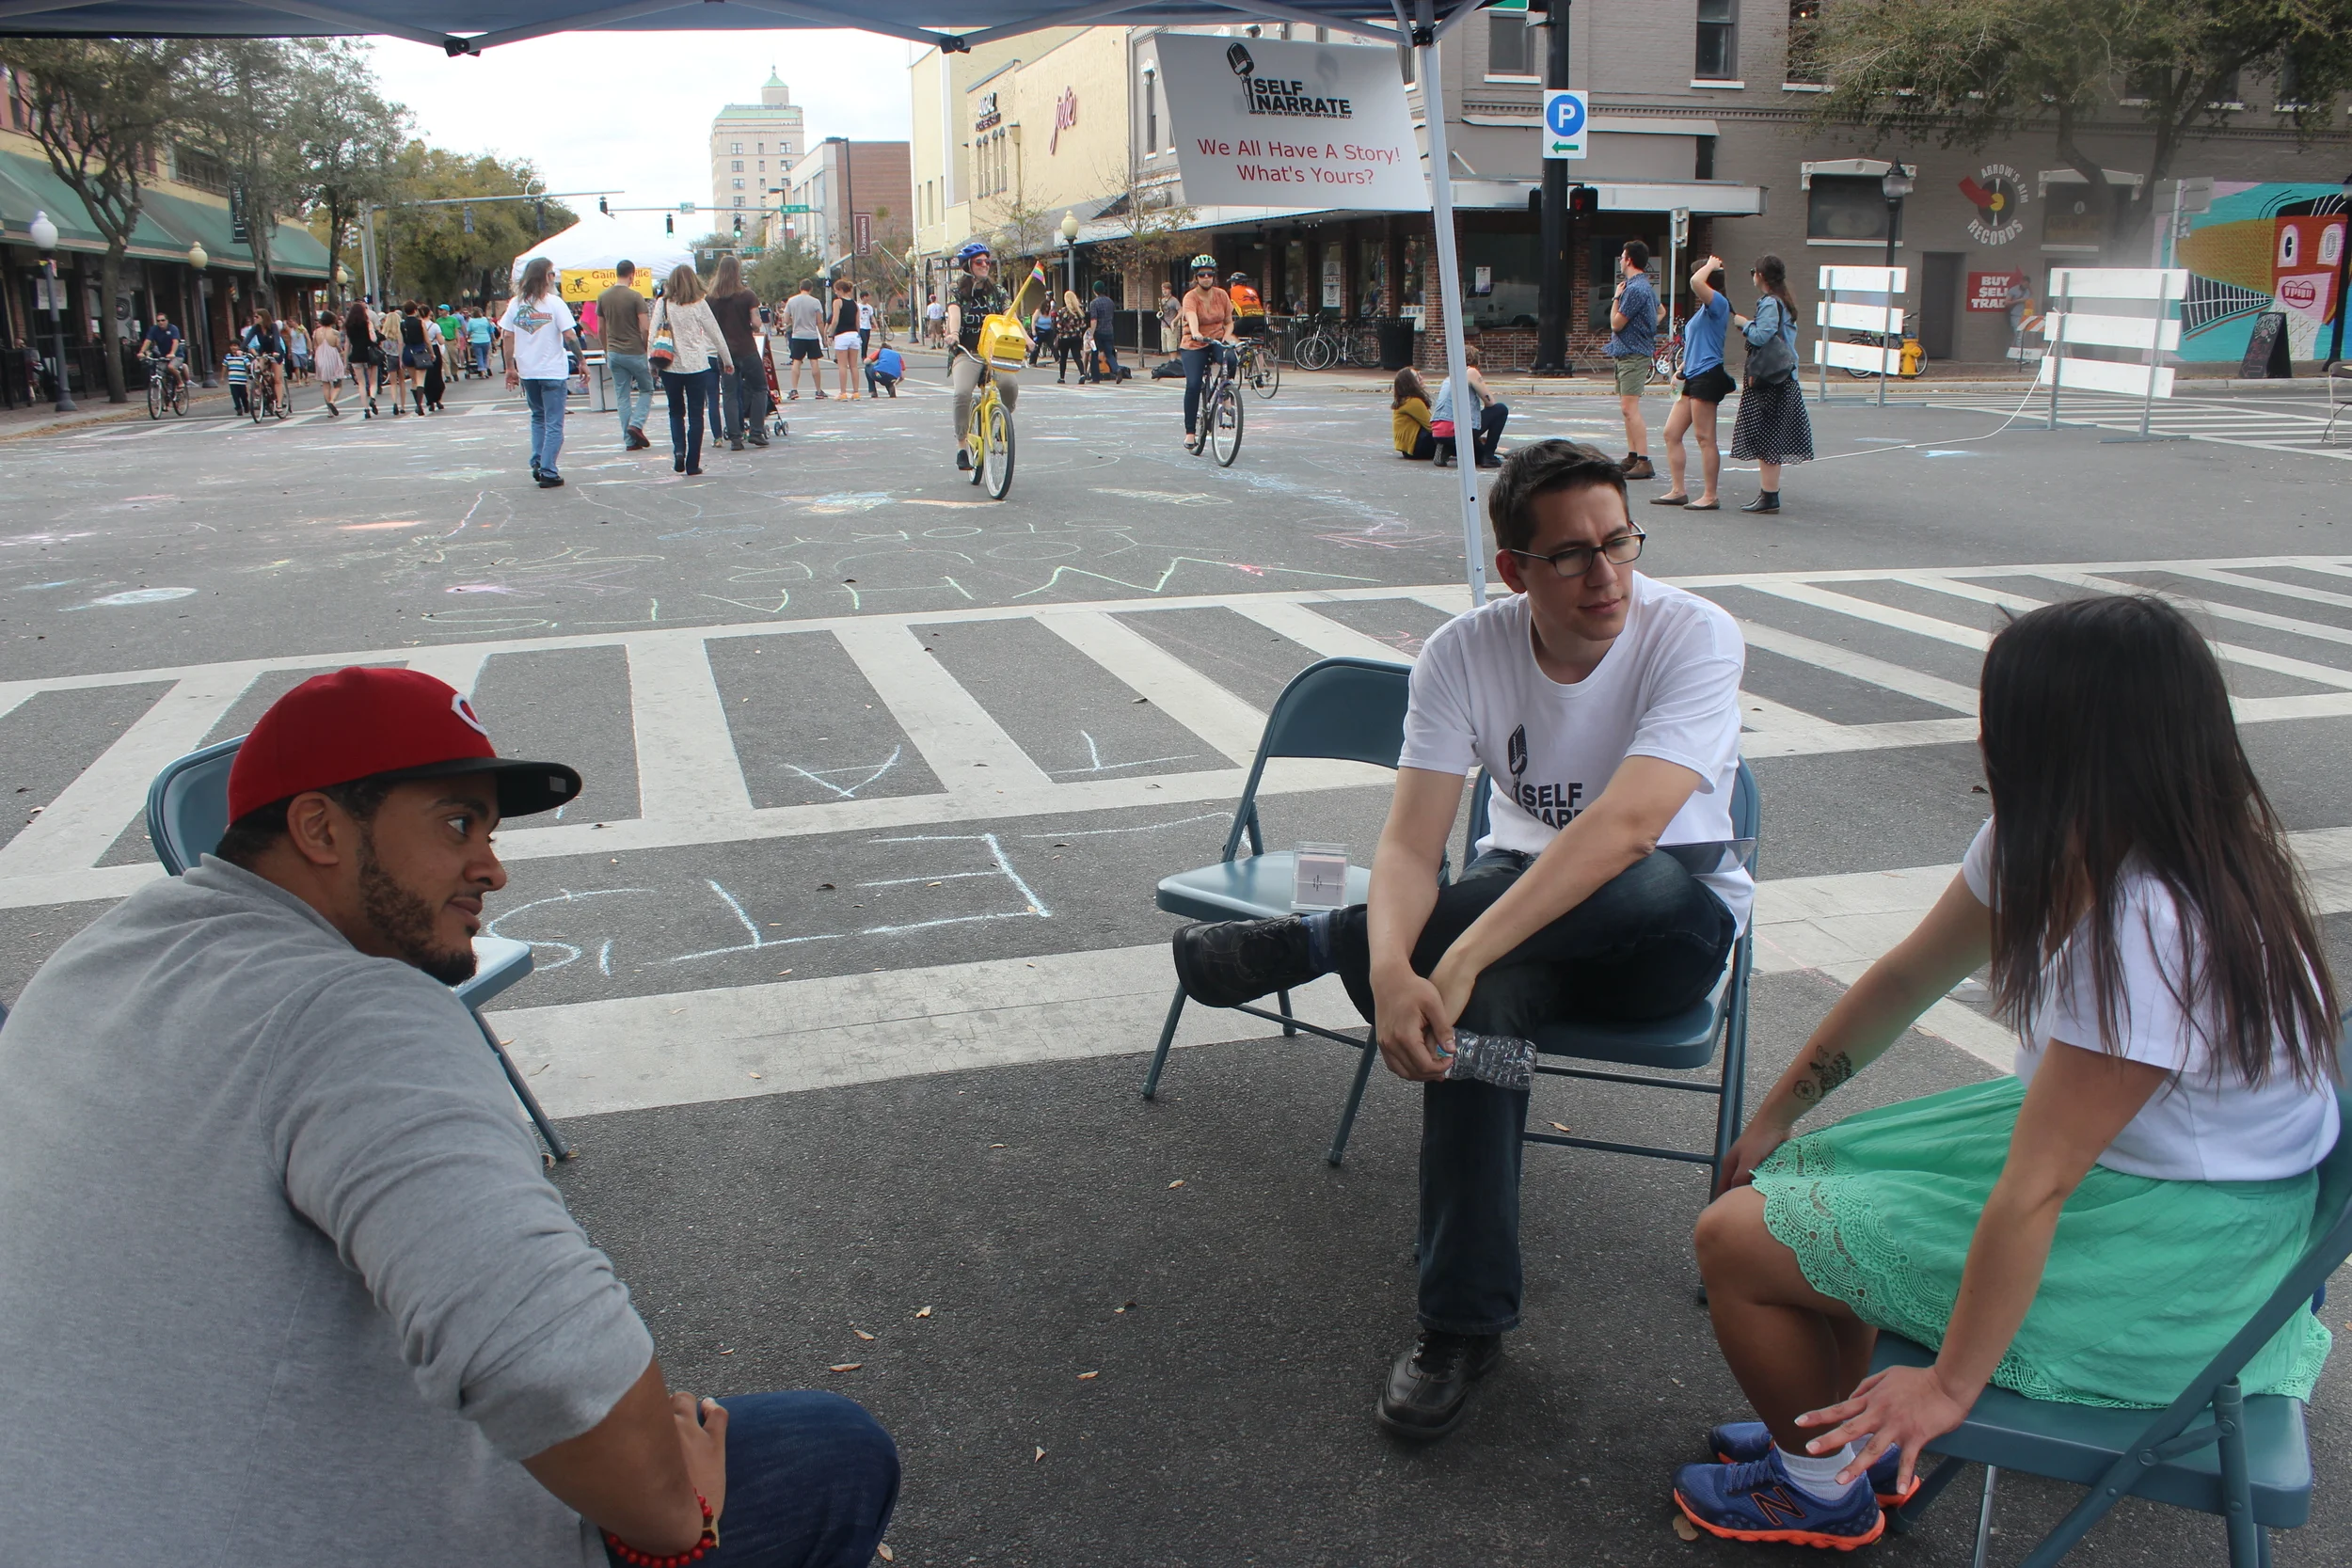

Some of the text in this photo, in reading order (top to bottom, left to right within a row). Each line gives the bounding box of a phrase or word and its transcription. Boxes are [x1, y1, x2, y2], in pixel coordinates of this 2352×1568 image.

[1253, 78, 1303, 96] SELF
[1256, 95, 1353, 115] NARRATE
[1558, 103, 1576, 129] P
[1197, 138, 1402, 166] We All Have A Story!
[1236, 164, 1375, 185] What's Yours?
[1980, 164, 2021, 183] ARROW'S
[1966, 218, 2024, 245] RECORDS
[591, 269, 650, 279] Gainille
[1981, 276, 2010, 286] BUY
[1971, 298, 2006, 309] TRAD
[421, 556, 1382, 636] WHAT'S
[1521, 783, 1583, 809] SELF
